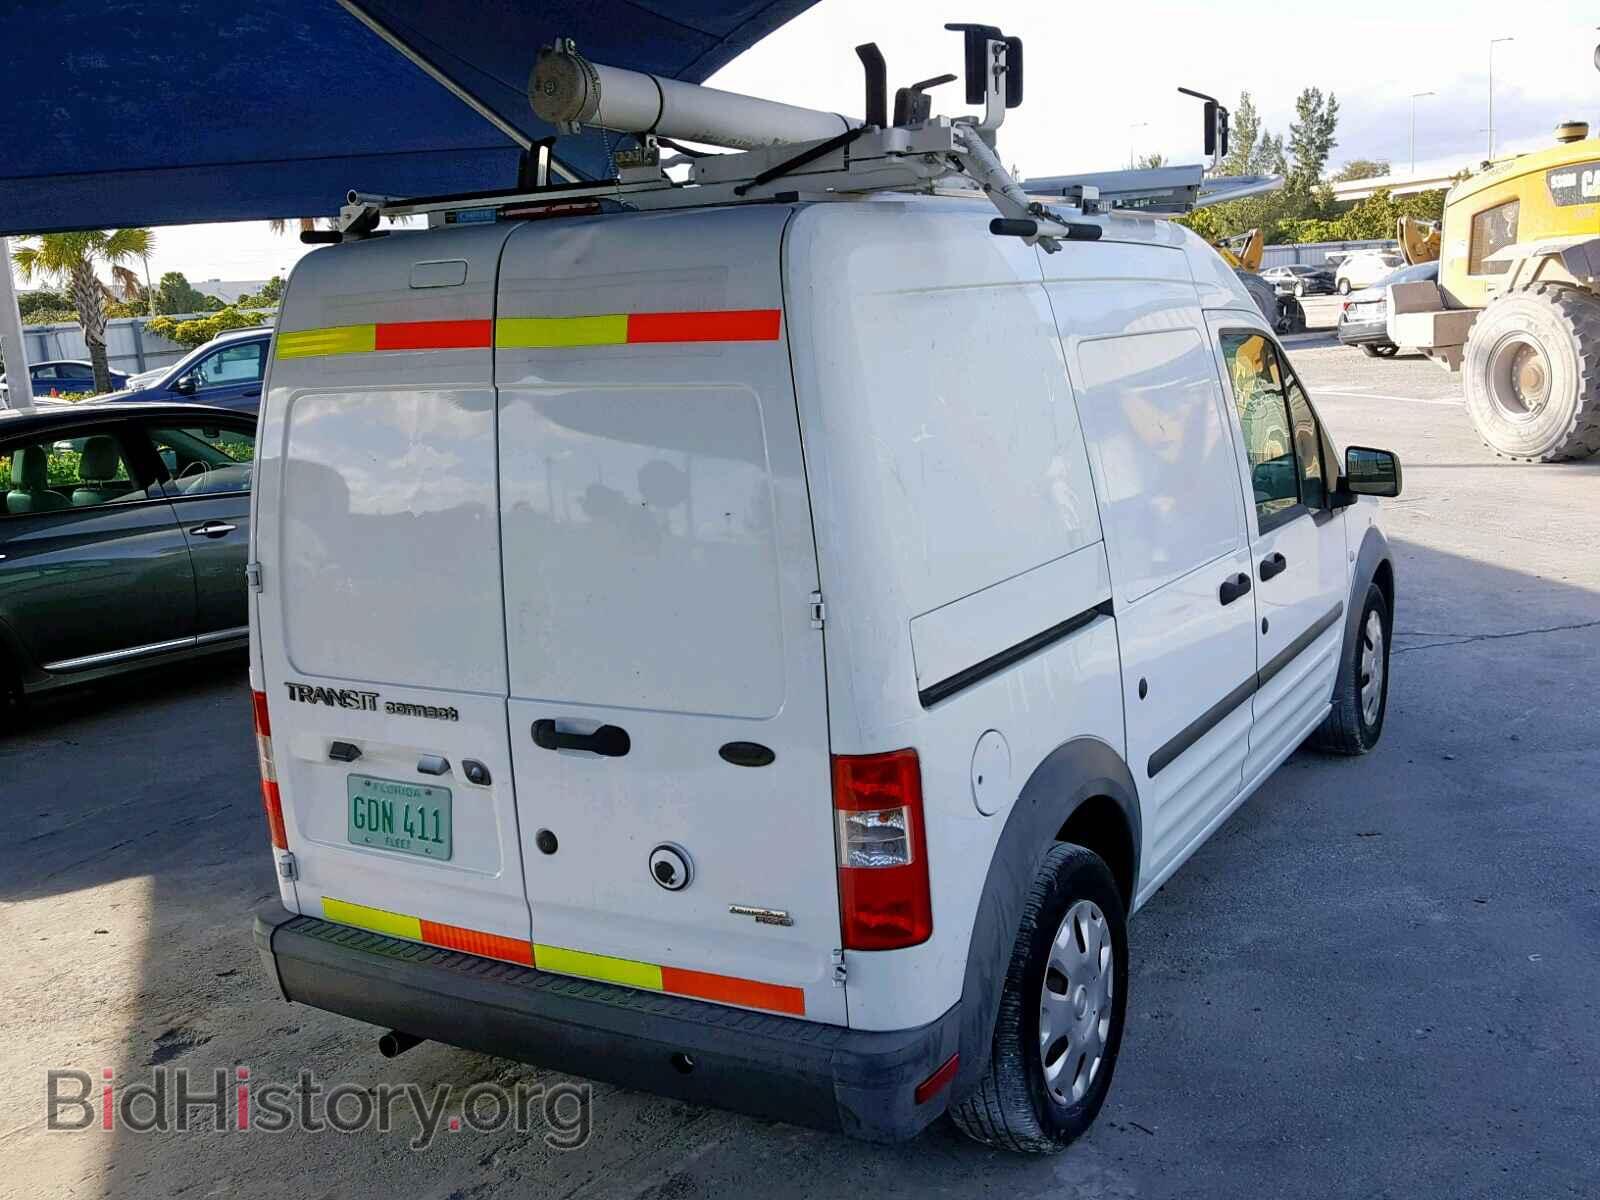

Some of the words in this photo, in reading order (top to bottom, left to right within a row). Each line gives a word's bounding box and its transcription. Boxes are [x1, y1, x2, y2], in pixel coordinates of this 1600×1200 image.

[284, 682, 380, 712] TRANSIT
[353, 796, 394, 834] GDN
[403, 804, 444, 844] 411
